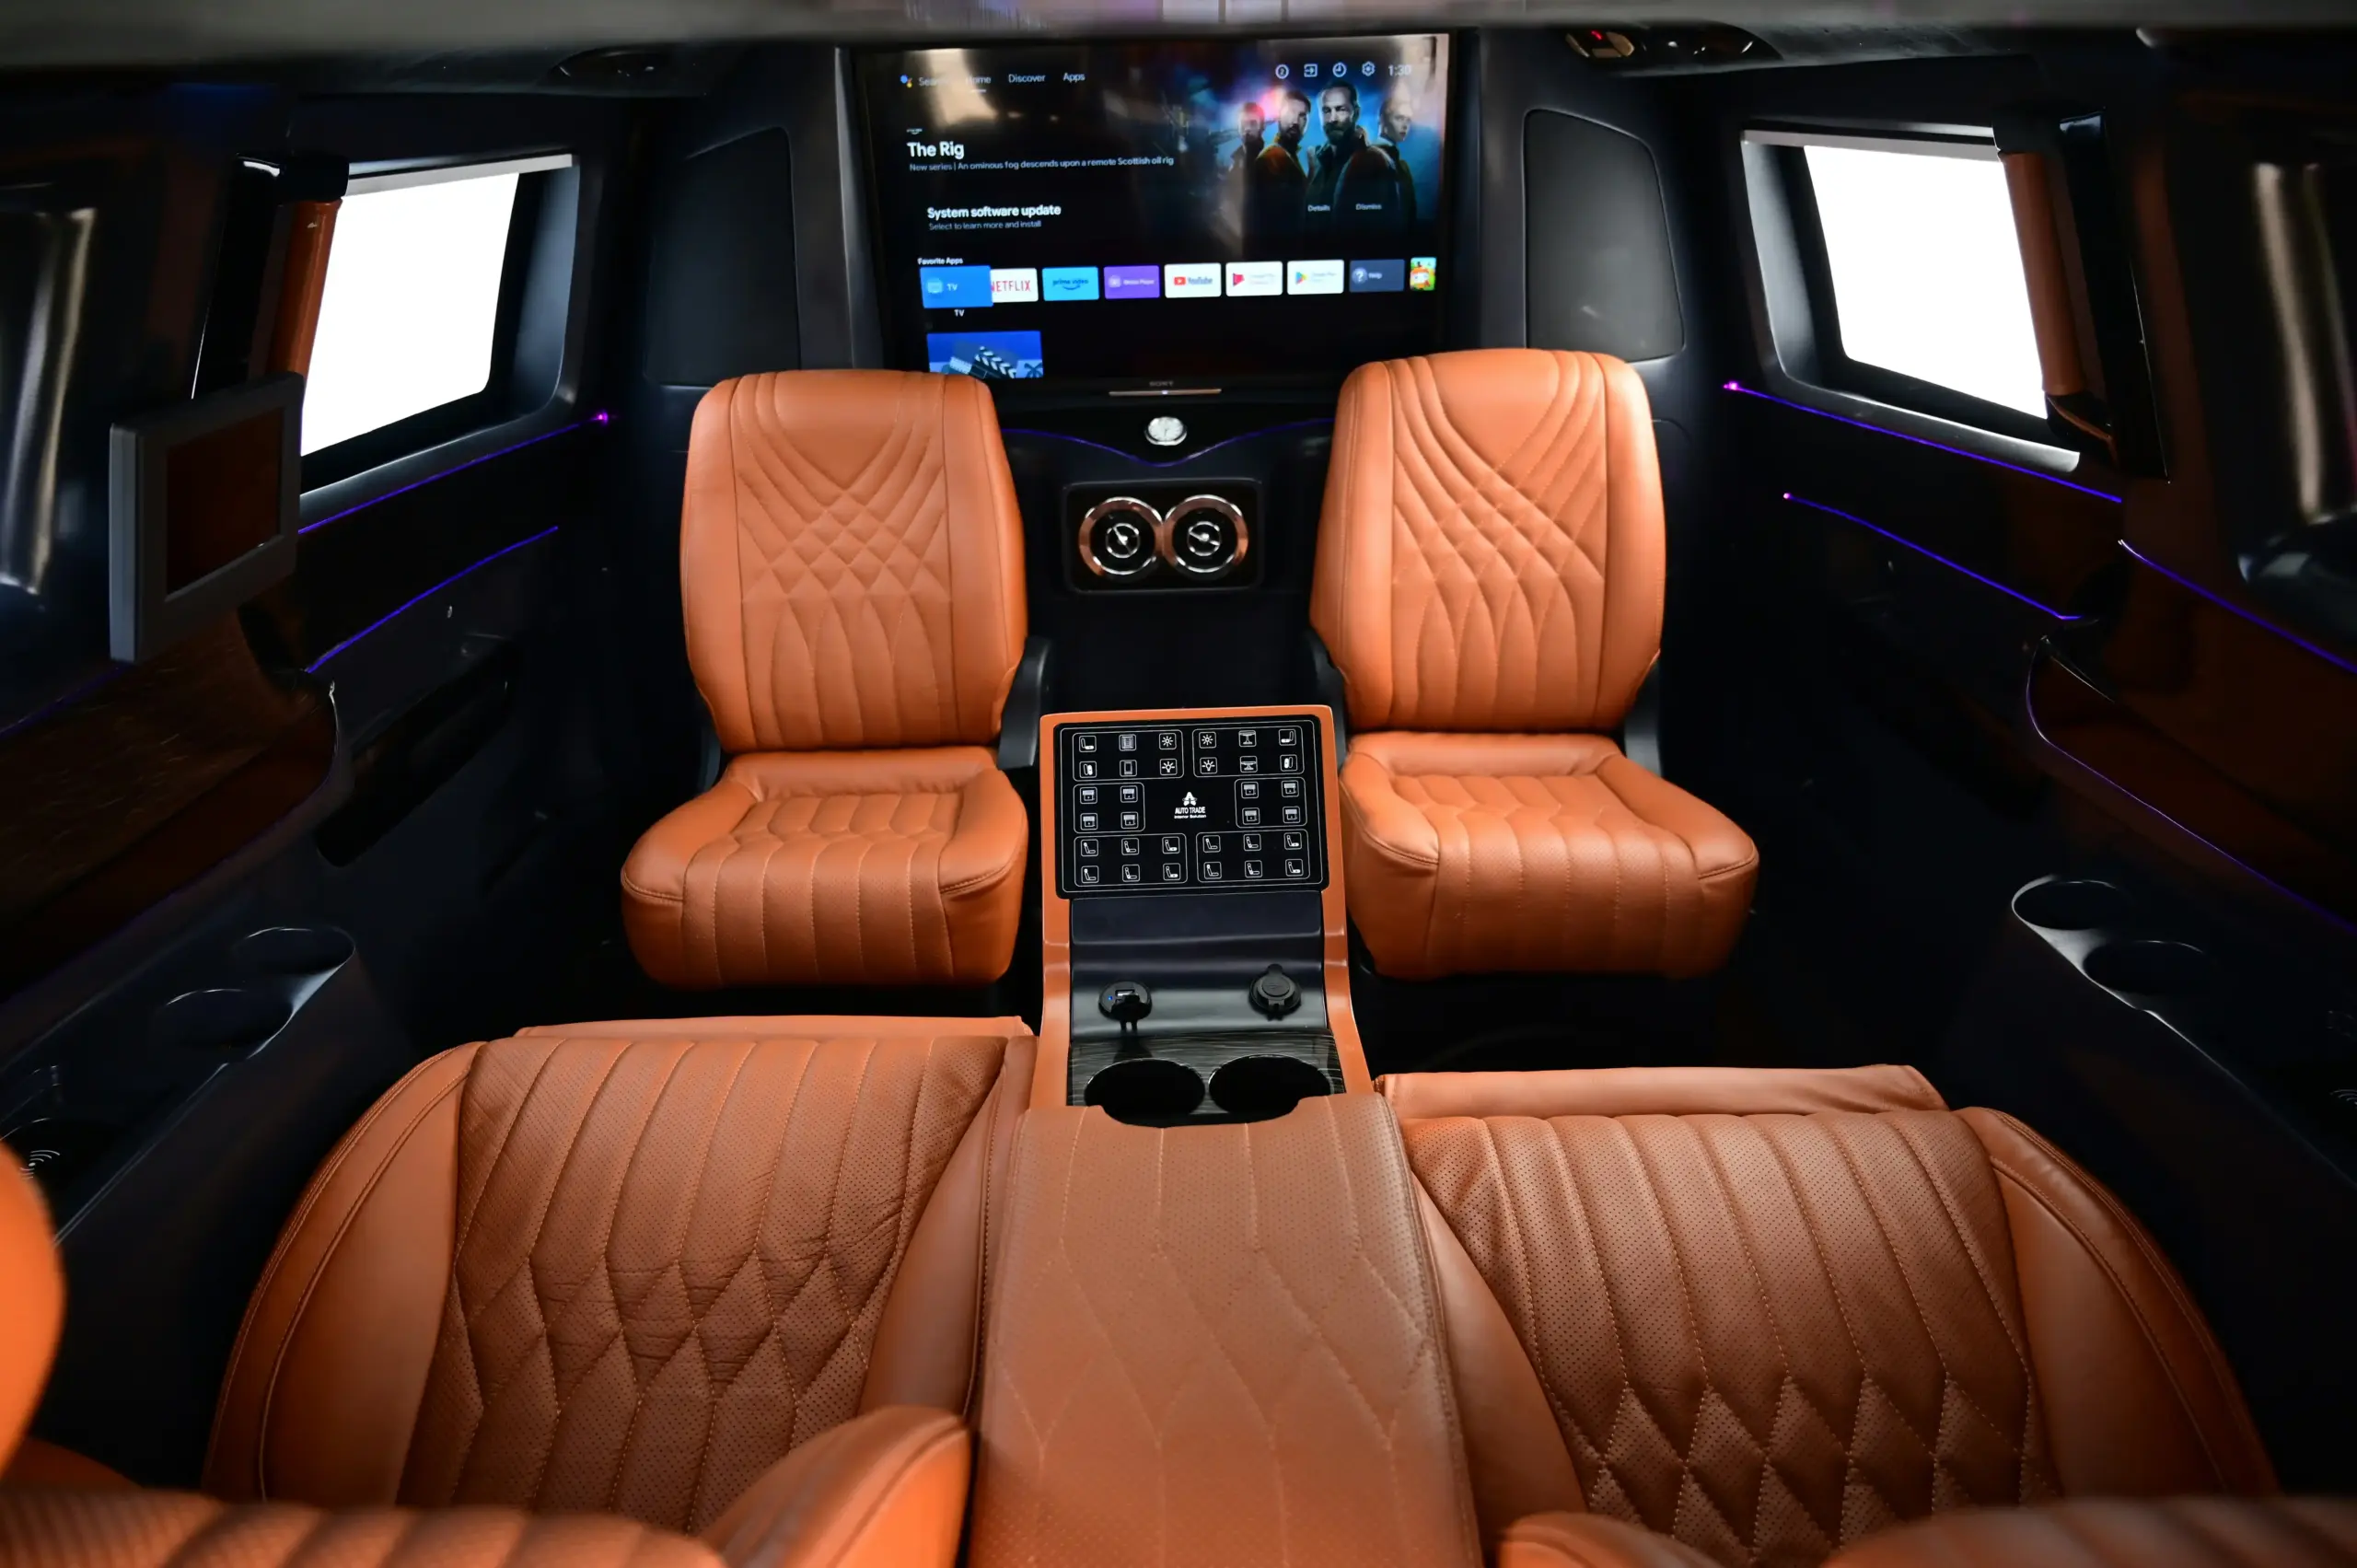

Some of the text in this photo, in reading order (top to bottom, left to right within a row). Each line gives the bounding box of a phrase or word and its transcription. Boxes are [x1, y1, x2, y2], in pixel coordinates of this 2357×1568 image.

[1008, 74, 1046, 84] Discover
[1062, 73, 1086, 84] Apps
[907, 141, 965, 159] The Rig
[910, 163, 928, 172] New
[929, 163, 952, 171] series
[958, 161, 970, 170] An
[970, 161, 1004, 170] ominous
[1004, 160, 1019, 170] fog
[1020, 159, 1059, 168] descends
[1060, 159, 1081, 168] upon
[1087, 158, 1116, 167] remote
[1117, 157, 1151, 166] Scottish
[1152, 156, 1161, 164] oil
[1162, 156, 1175, 166] rig
[927, 204, 1062, 221] System software update
[928, 219, 1042, 231] Select to learn more and install
[917, 257, 964, 266] Favorite Apps
[946, 283, 958, 292] TV
[954, 308, 965, 318] TV
[1174, 806, 1206, 815] AUTO TRADE
